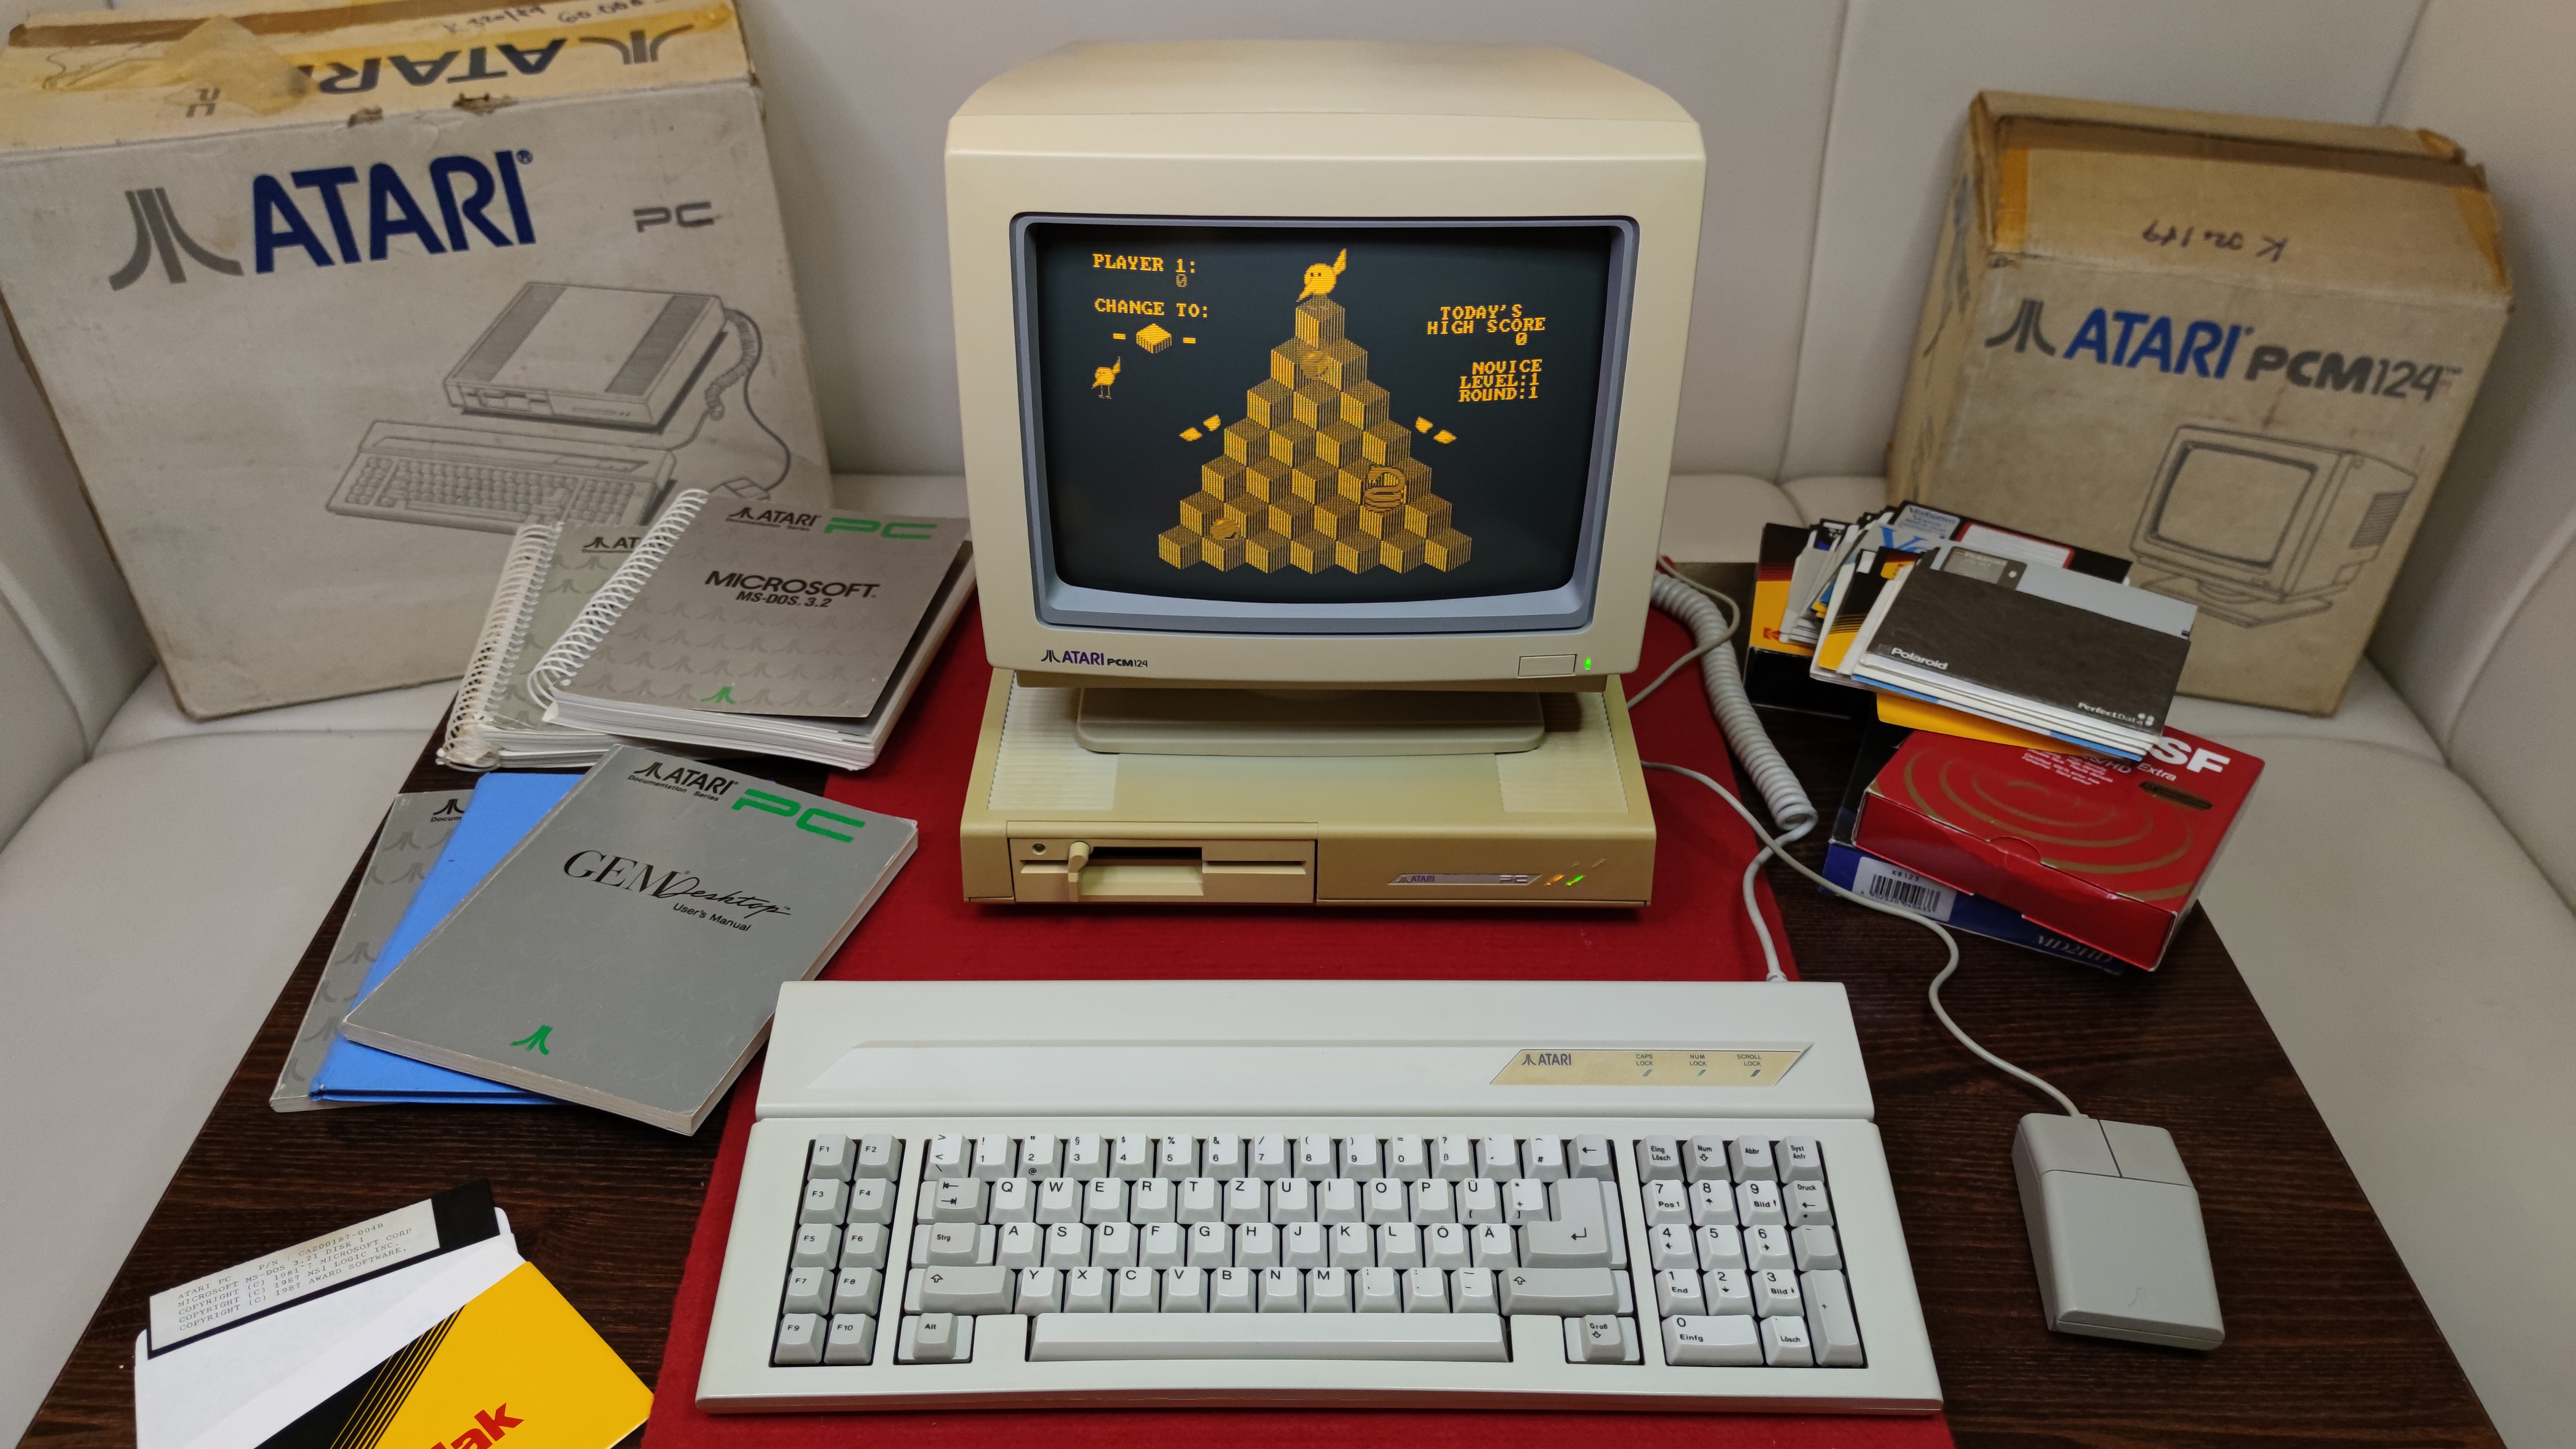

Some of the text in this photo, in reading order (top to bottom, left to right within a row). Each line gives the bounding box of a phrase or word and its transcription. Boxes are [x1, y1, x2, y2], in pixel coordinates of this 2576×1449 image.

[299, 38, 568, 95] ATAR
[634, 201, 715, 233] PC
[1093, 254, 1195, 274] PLAYER 1:
[1094, 298, 1208, 318] CHANGE TO:
[1440, 304, 1523, 320] TODAY'S
[1427, 317, 1546, 335] HIGH SCORE
[1472, 359, 1543, 375] NOVICE
[824, 517, 938, 540] PC
[1062, 650, 1148, 668] ATARI PCM124
[1890, 647, 1949, 671] Polaroid
[2136, 762, 2177, 782] Extra
[627, 774, 720, 802] Documentation Series
[731, 788, 866, 843] PC
[1411, 875, 1435, 883] ATARI
[673, 902, 752, 932] User's Manual
[1538, 1053, 1572, 1066] ATARI
[1074, 1153, 1080, 1161] 3
[1167, 1154, 1173, 1162] 5
[1213, 1154, 1219, 1162] 6
[1305, 1154, 1312, 1162] 8
[1001, 1181, 1013, 1193] Q
[1049, 1181, 1063, 1192] W
[1095, 1181, 1105, 1192] E
[1142, 1181, 1152, 1191] R
[1189, 1181, 1198, 1192] T
[1235, 1180, 1245, 1191] Z
[1282, 1181, 1291, 1192] U
[1328, 1181, 1331, 1192] I
[1376, 1182, 1387, 1193] O
[1422, 1182, 1431, 1192] P
[1468, 1180, 1478, 1192] Ü
[1655, 1183, 1664, 1194] 7
[1703, 1182, 1712, 1193] 8
[1750, 1183, 1759, 1194] 9
[1008, 1225, 1018, 1236] A
[1057, 1226, 1067, 1237] S
[1104, 1225, 1114, 1236] D
[1151, 1225, 1161, 1236] F
[1199, 1226, 1210, 1237] G
[1246, 1225, 1256, 1237] H
[1294, 1226, 1301, 1236] J
[1341, 1225, 1351, 1237] K
[1389, 1225, 1397, 1237] L
[1437, 1225, 1449, 1238] Ö
[1485, 1226, 1495, 1238] Ä
[1662, 1228, 1672, 1238] 4
[1710, 1228, 1719, 1238] 5
[1758, 1229, 1767, 1239] 6
[936, 1234, 951, 1242] Strg
[178, 1288, 240, 1315] COPYRIGHT
[320, 1239, 379, 1265] MICROSOFT
[386, 1228, 412, 1241] CORP
[178, 1281, 238, 1308] MICROSOFT
[245, 1265, 286, 1283] MS-DOS
[293, 1253, 318, 1266] 3.21
[326, 1241, 352, 1255] DISK
[1029, 1269, 1039, 1280] Y
[1077, 1269, 1088, 1280] X
[1126, 1270, 1136, 1280] C
[1174, 1269, 1184, 1280] V
[1222, 1270, 1232, 1280] B
[1271, 1269, 1280, 1280] N
[1318, 1270, 1330, 1280] M
[1668, 1271, 1674, 1280] 1
[1717, 1271, 1727, 1281] 2
[1767, 1272, 1776, 1282] 3
[178, 1283, 210, 1300] ATARI
[218, 1276, 232, 1285] PC
[258, 1259, 279, 1271] P/N
[178, 1296, 240, 1323] COPYRIGHT
[275, 1275, 300, 1288] 1987
[307, 1266, 326, 1277] NSI
[334, 1251, 367, 1268] LOGIC
[374, 1242, 398, 1253] INC.
[179, 1304, 241, 1331] COPYRIGHT
[276, 1282, 301, 1296] 1987
[309, 1268, 342, 1284] AWARD
